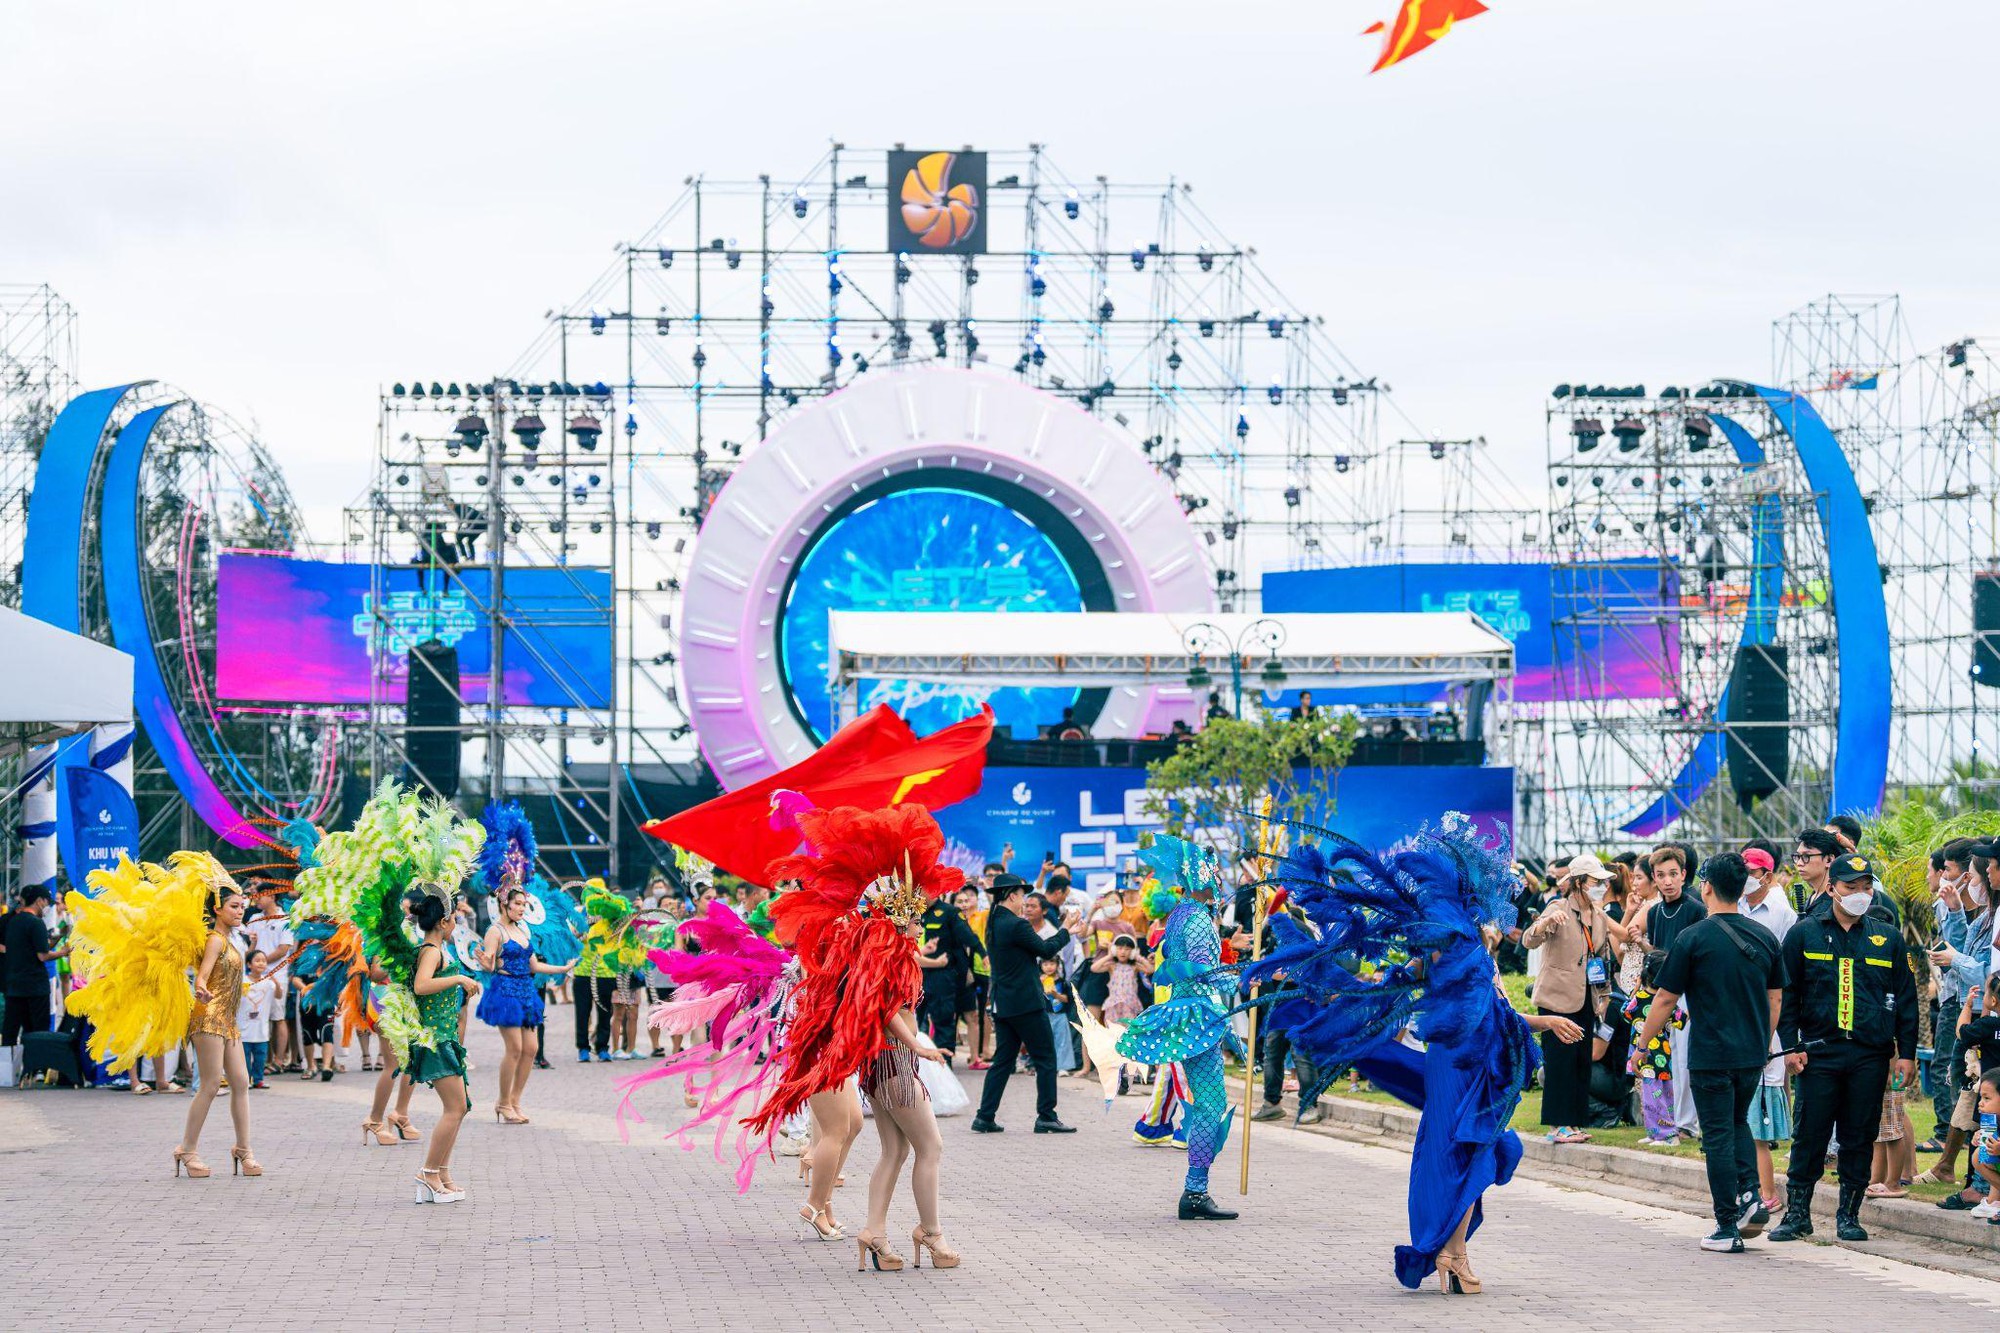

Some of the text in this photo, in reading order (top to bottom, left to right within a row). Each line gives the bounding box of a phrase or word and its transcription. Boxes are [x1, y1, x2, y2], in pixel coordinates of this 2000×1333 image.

[850, 566, 1029, 601] LET'S
[1421, 590, 1521, 612] LET'S
[88, 847, 108, 860] KHU
[1841, 959, 1850, 1029] SECURITY
